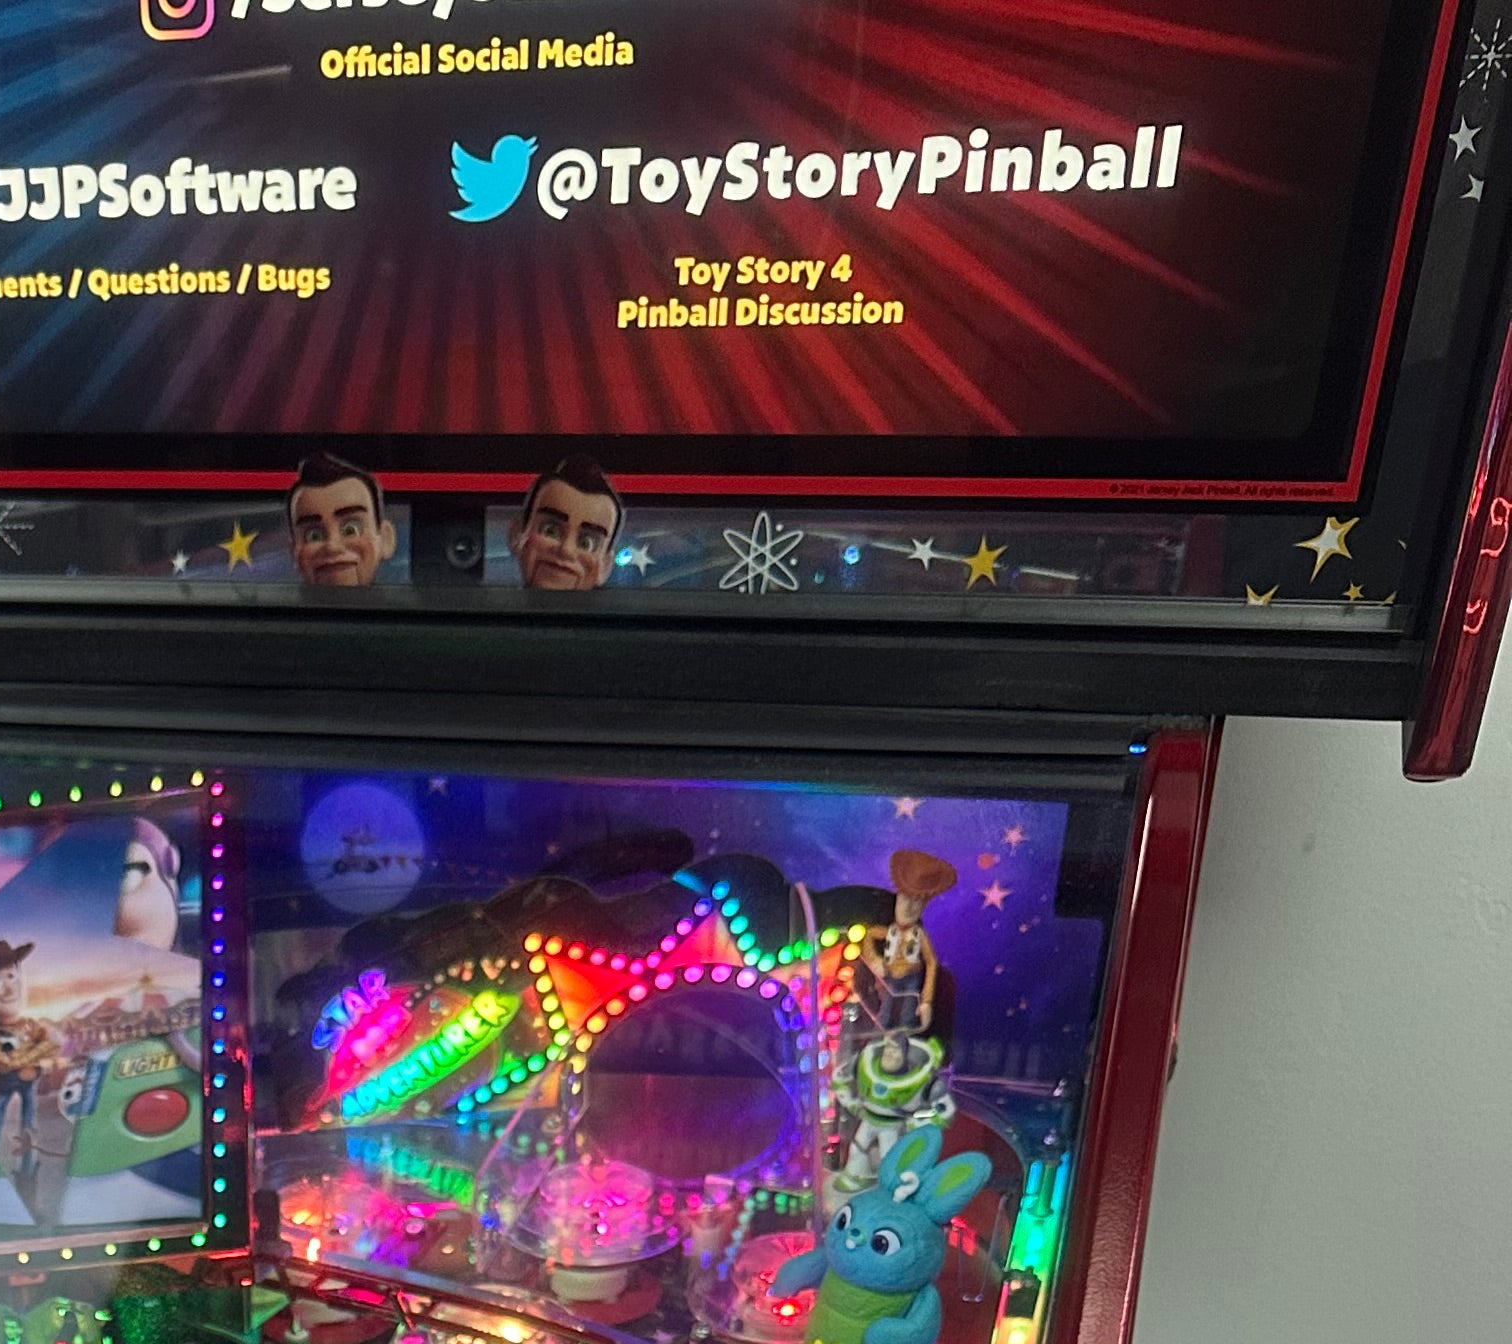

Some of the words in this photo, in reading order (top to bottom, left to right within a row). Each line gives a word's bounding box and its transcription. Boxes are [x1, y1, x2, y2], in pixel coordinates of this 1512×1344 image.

[438, 38, 530, 74] Social
[538, 33, 634, 69] Media
[537, 124, 1184, 220] @ToyStoryPinball
[67, 267, 85, 300] /
[88, 264, 233, 305] Questions
[235, 264, 252, 297] /
[257, 263, 332, 300] Bugs
[674, 254, 733, 293] Toy
[736, 253, 826, 291] Story
[828, 253, 853, 284] 4
[616, 296, 730, 332] Pinball
[734, 293, 906, 329] Discussion
[341, 989, 510, 1120] ADVENTURER
